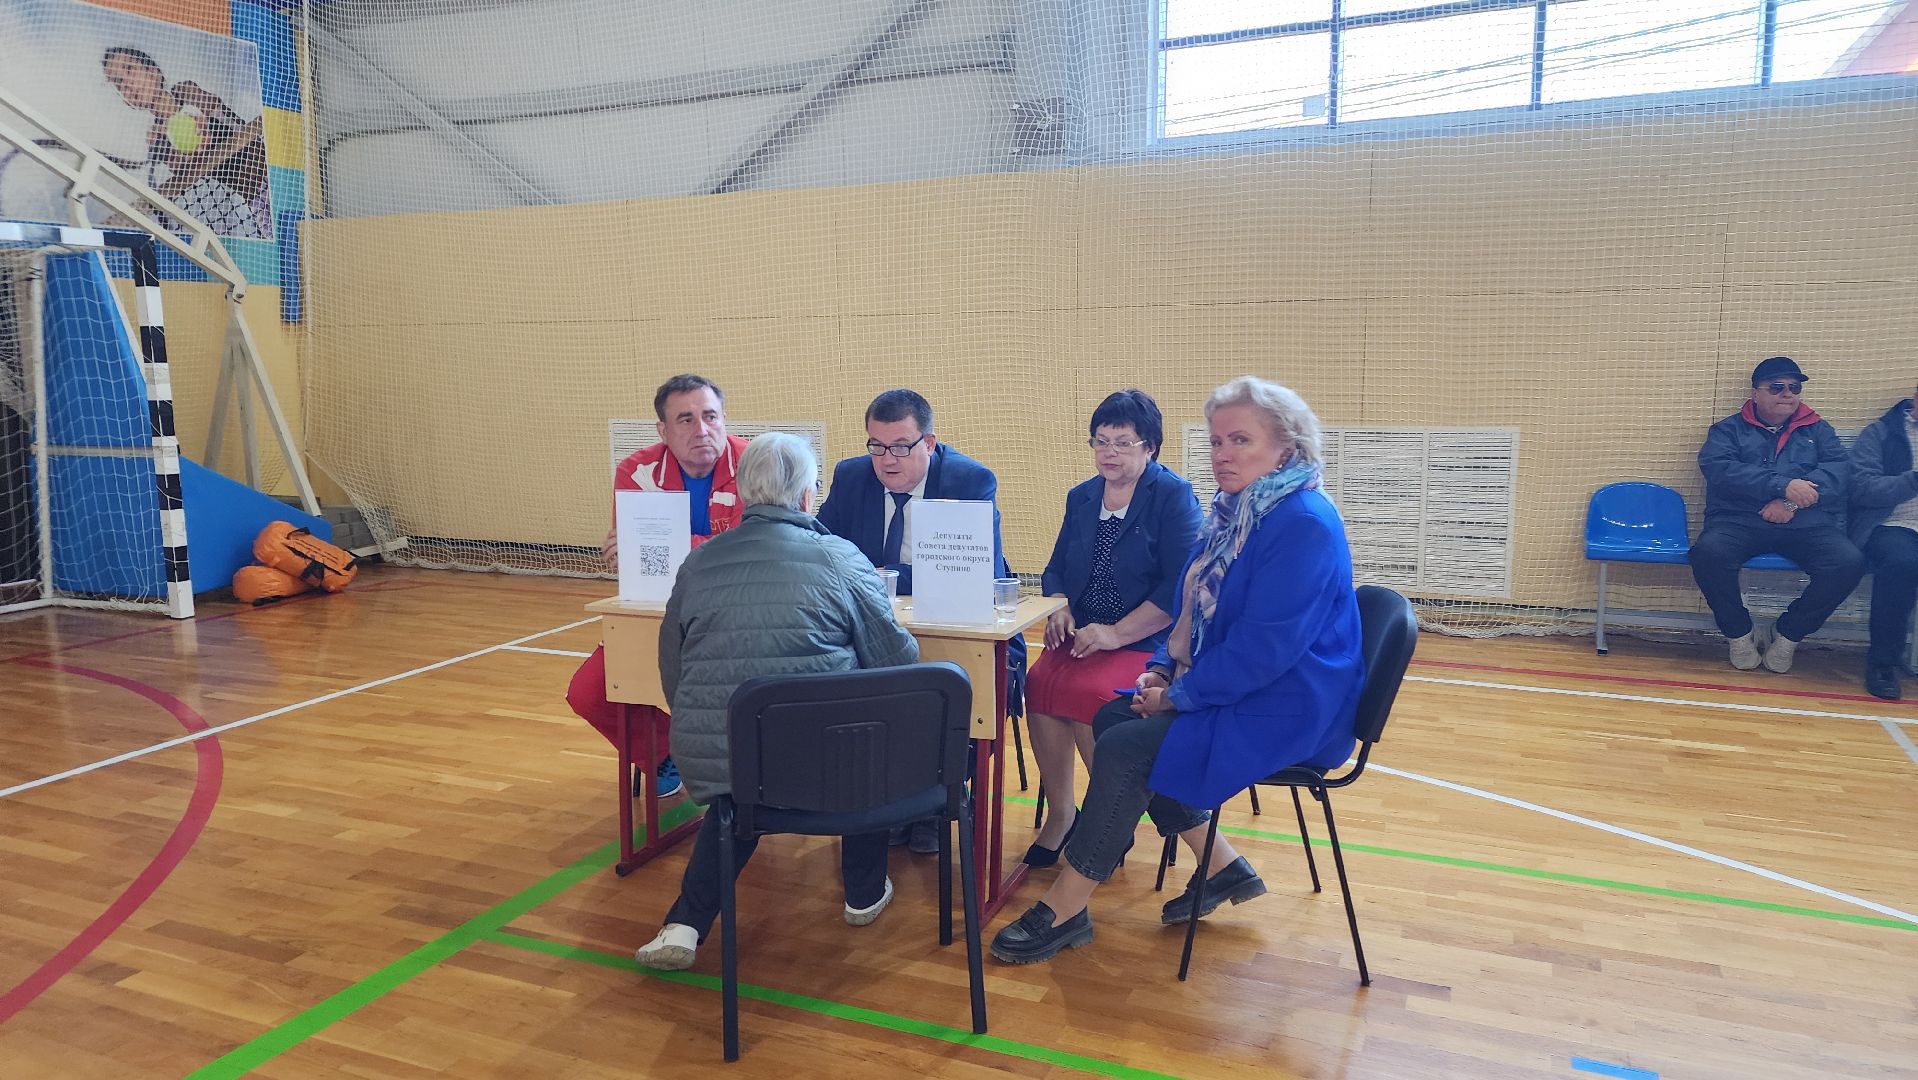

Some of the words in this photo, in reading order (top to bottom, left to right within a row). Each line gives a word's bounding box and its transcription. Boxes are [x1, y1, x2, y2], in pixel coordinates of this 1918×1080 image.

[933, 531, 973, 540] Депутаты
[918, 541, 946, 550] Совета
[947, 543, 989, 552] депутатов
[916, 553, 960, 561] городского
[962, 555, 990, 563] округа
[935, 563, 971, 573] Ступино
